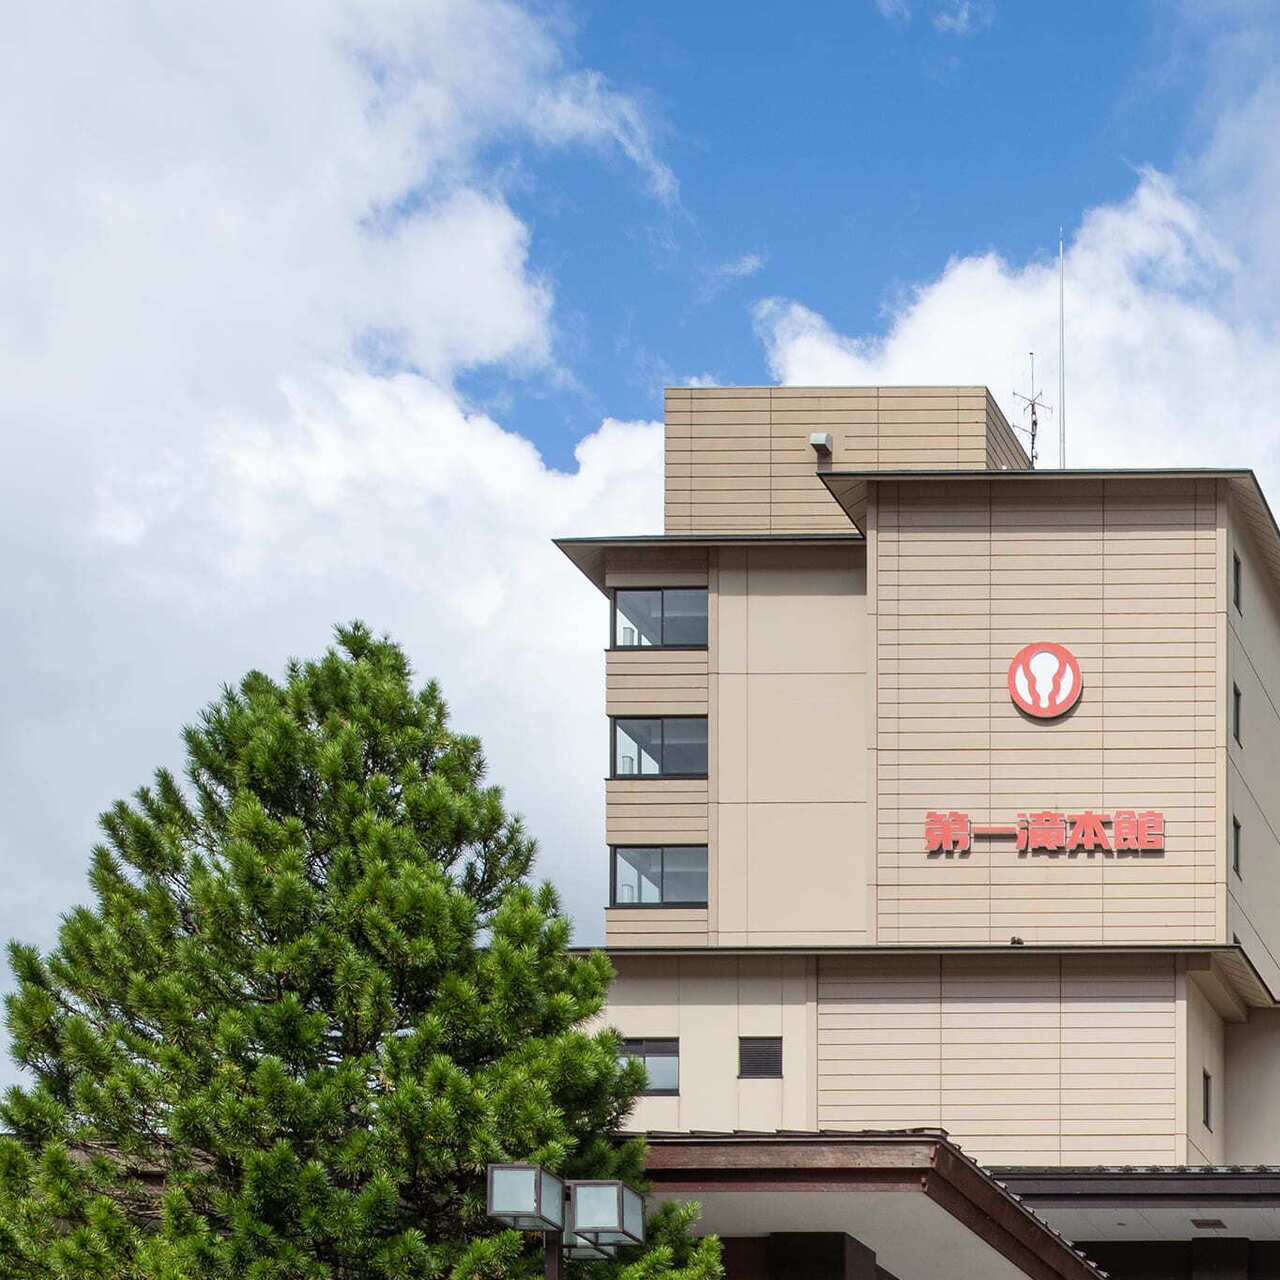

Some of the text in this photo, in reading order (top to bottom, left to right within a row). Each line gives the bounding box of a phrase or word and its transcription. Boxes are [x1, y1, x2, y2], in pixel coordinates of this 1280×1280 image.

[924, 811, 1162, 848] 第一滝本館
